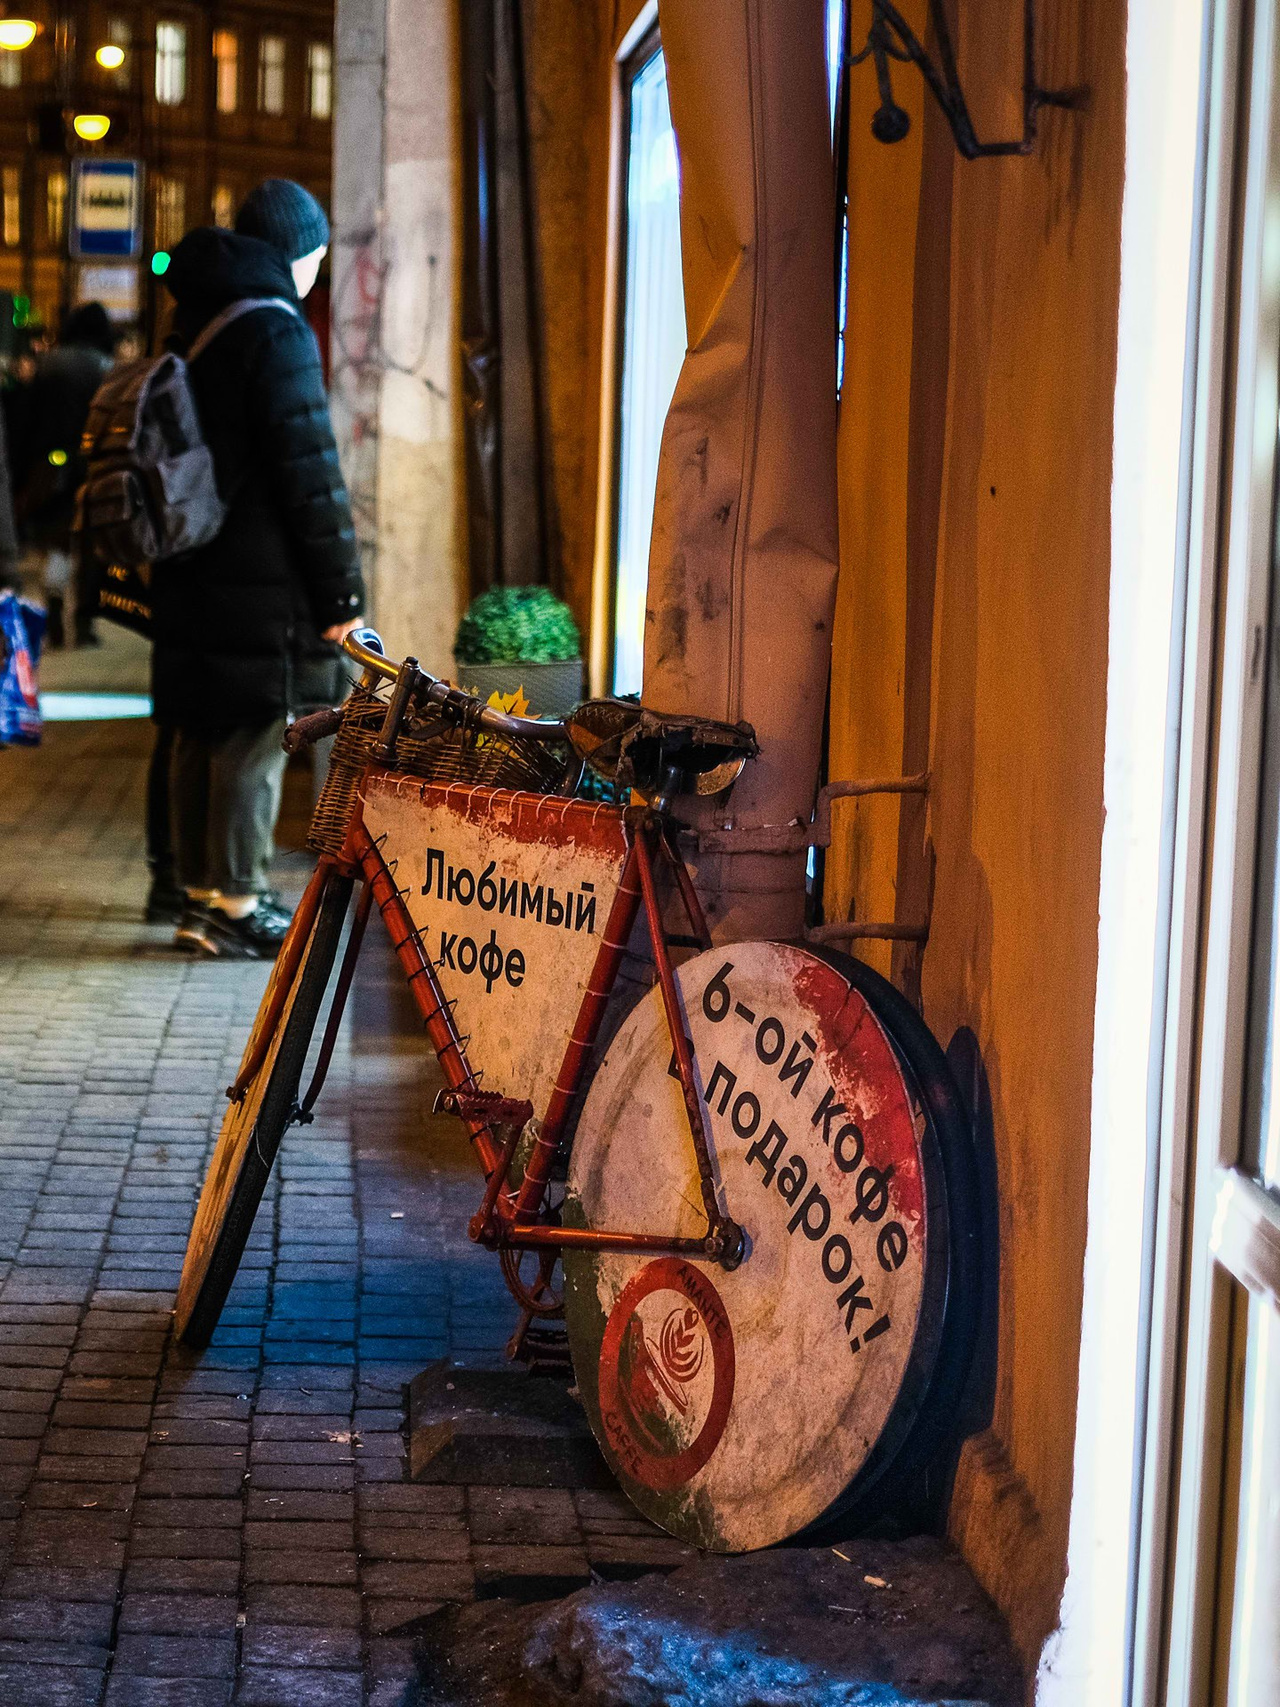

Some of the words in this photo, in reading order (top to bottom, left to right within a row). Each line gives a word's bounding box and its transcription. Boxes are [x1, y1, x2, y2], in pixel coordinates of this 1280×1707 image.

[421, 847, 597, 935] Любимый
[439, 929, 526, 994] кофе
[702, 961, 817, 1099] 6-ой
[811, 1085, 909, 1273] кофе
[703, 1060, 891, 1355] подарок!
